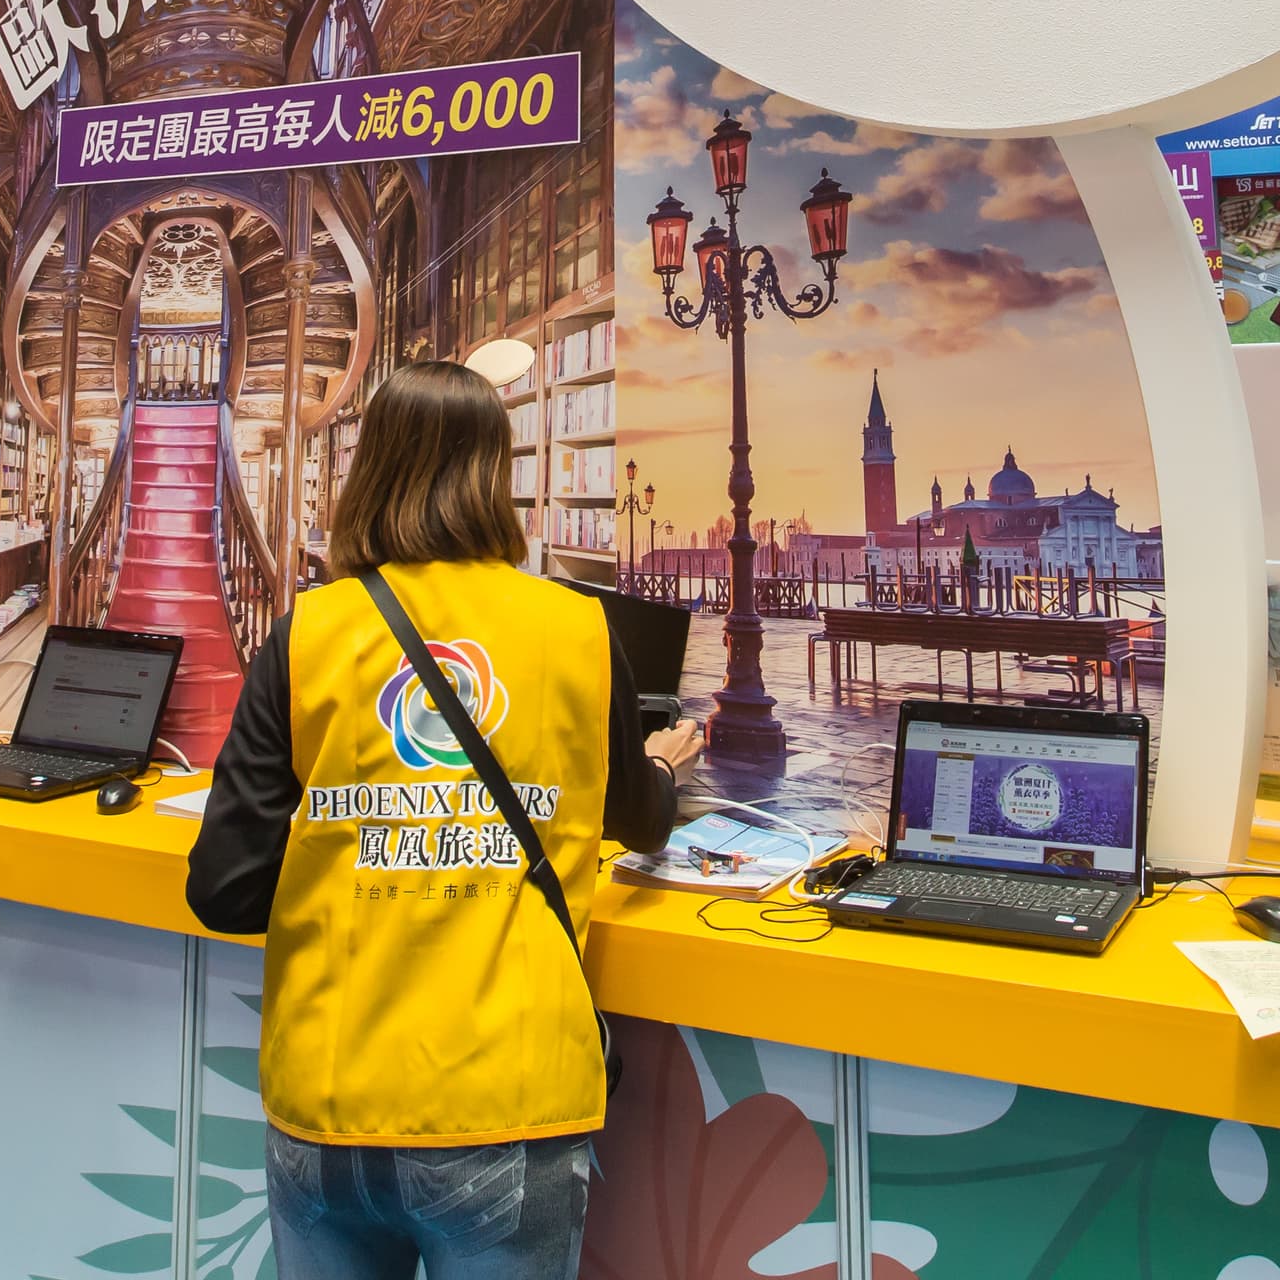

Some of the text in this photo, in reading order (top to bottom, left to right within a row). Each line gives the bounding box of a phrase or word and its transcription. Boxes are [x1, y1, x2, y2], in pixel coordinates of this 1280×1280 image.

[80, 72, 554, 168] 限定團最高每人減6,000
[310, 785, 453, 818] PHOENIX
[357, 824, 519, 868] 鳳凰旅遊
